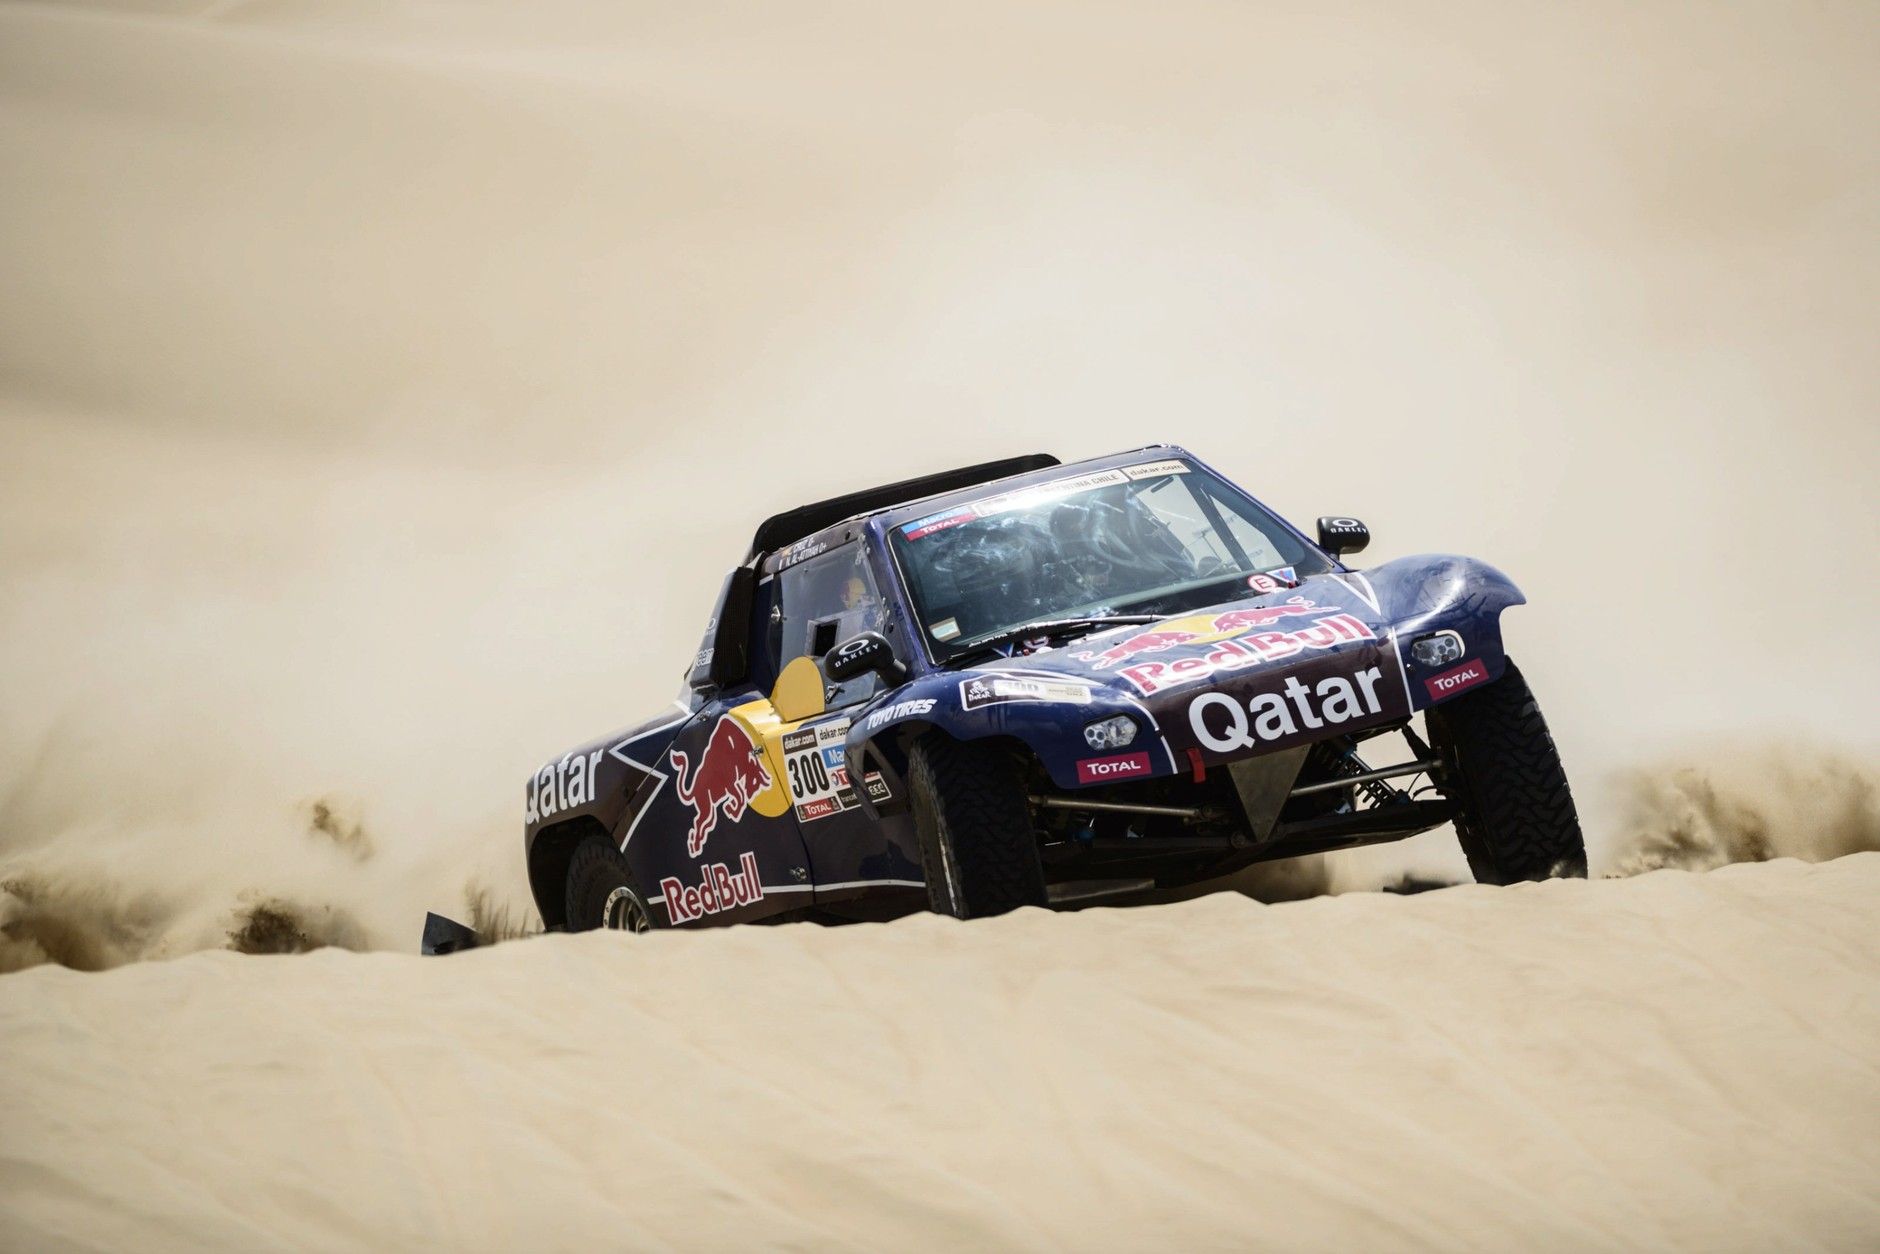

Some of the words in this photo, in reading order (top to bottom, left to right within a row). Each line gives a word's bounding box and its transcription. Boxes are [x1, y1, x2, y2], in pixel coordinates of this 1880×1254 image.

[1130, 463, 1184, 477] dakar.com
[1091, 473, 1119, 485] CHILE
[918, 511, 953, 527] Macro
[920, 518, 960, 534] TOTAL
[834, 643, 879, 668] OAKLEY
[1117, 641, 1251, 695] Red
[1244, 614, 1376, 660] Bull
[1434, 669, 1479, 690] TOTAL
[968, 690, 992, 702] DAKAR
[867, 704, 896, 730] TOYO
[893, 698, 938, 719] TIRES
[1188, 665, 1382, 753] Qatar
[784, 733, 816, 750] dakar.com
[788, 751, 830, 799] 300
[1087, 760, 1141, 775] TOTAL
[805, 802, 832, 815] TOTAL
[660, 864, 720, 925] Red
[711, 851, 763, 910] Bull
